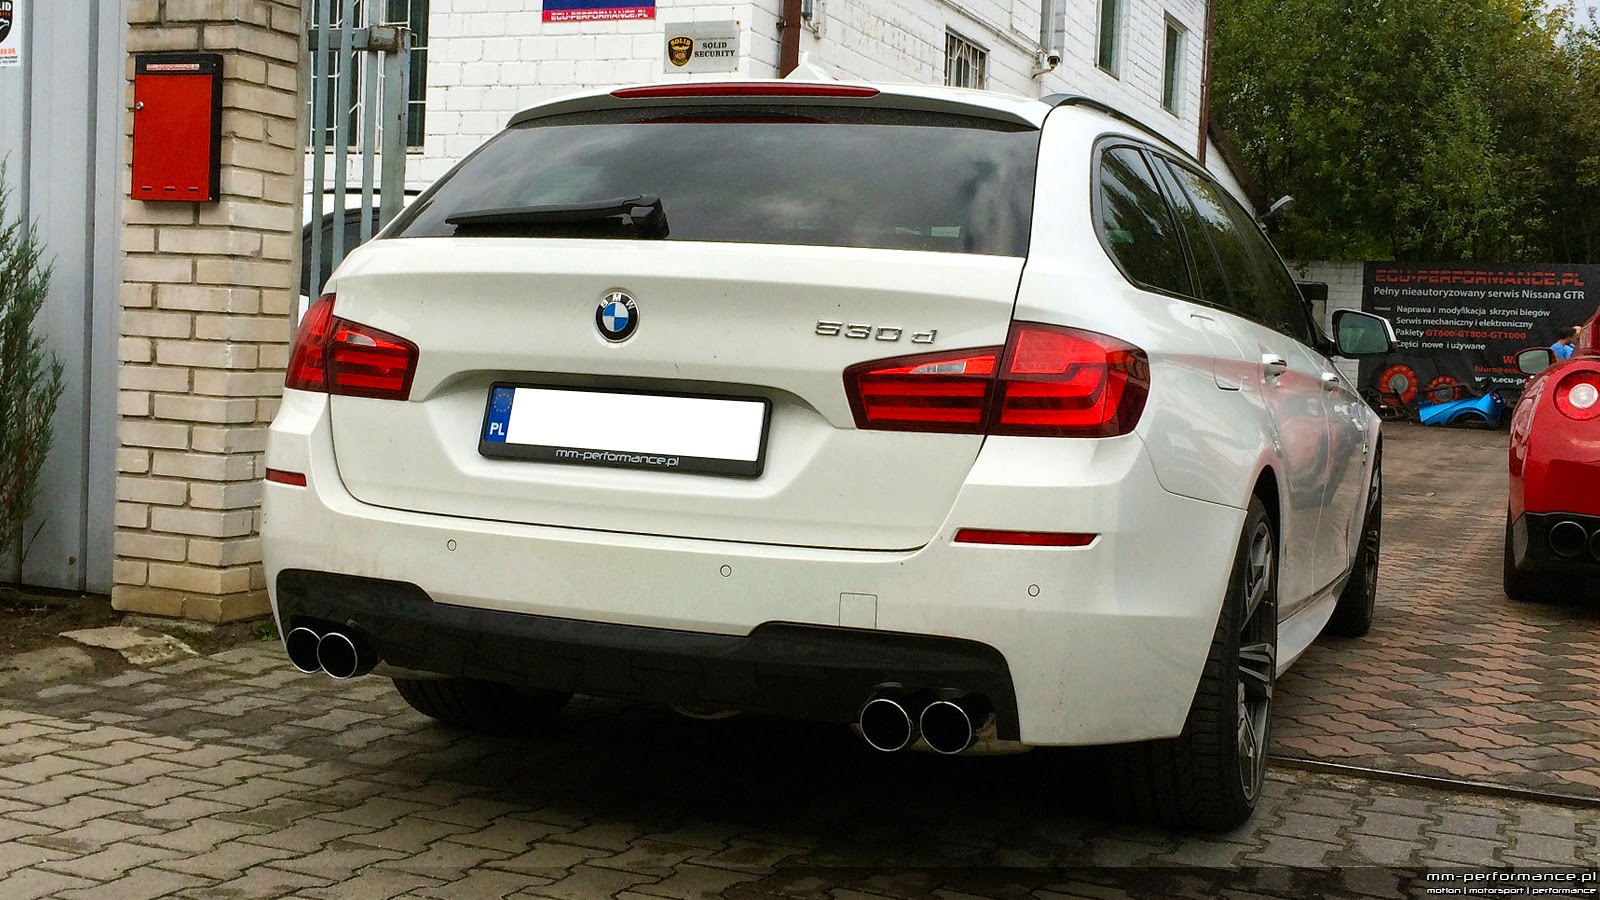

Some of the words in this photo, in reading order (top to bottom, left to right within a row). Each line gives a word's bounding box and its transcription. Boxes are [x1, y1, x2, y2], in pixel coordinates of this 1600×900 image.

[551, 9, 648, 20] ECU-PERFORMANCE.PL
[1375, 269, 1585, 287] ECU-PERFORMANCE.PL
[1373, 286, 1401, 297] Pełny
[1401, 287, 1486, 299] nieautoryzowany
[1488, 289, 1520, 299] serwis
[1522, 289, 1561, 299] Nissana
[1563, 291, 1585, 300] GTR
[600, 293, 636, 310] BMW
[1397, 306, 1432, 315] Naprawa
[1438, 306, 1486, 316] modyfikacja
[1489, 307, 1519, 317] skrzyni
[1519, 308, 1551, 318] biegów
[1396, 317, 1422, 325] Serwis
[1422, 318, 1474, 328] mechaniczny
[1479, 319, 1533, 329] elektroniczny
[1395, 329, 1425, 337] Pakiety
[1425, 330, 1526, 340] GT600-GT800-GT1000
[1422, 341, 1443, 349] nowe
[1450, 341, 1486, 351] używane
[489, 422, 505, 436] PL
[555, 448, 680, 467] mm-performance.pl
